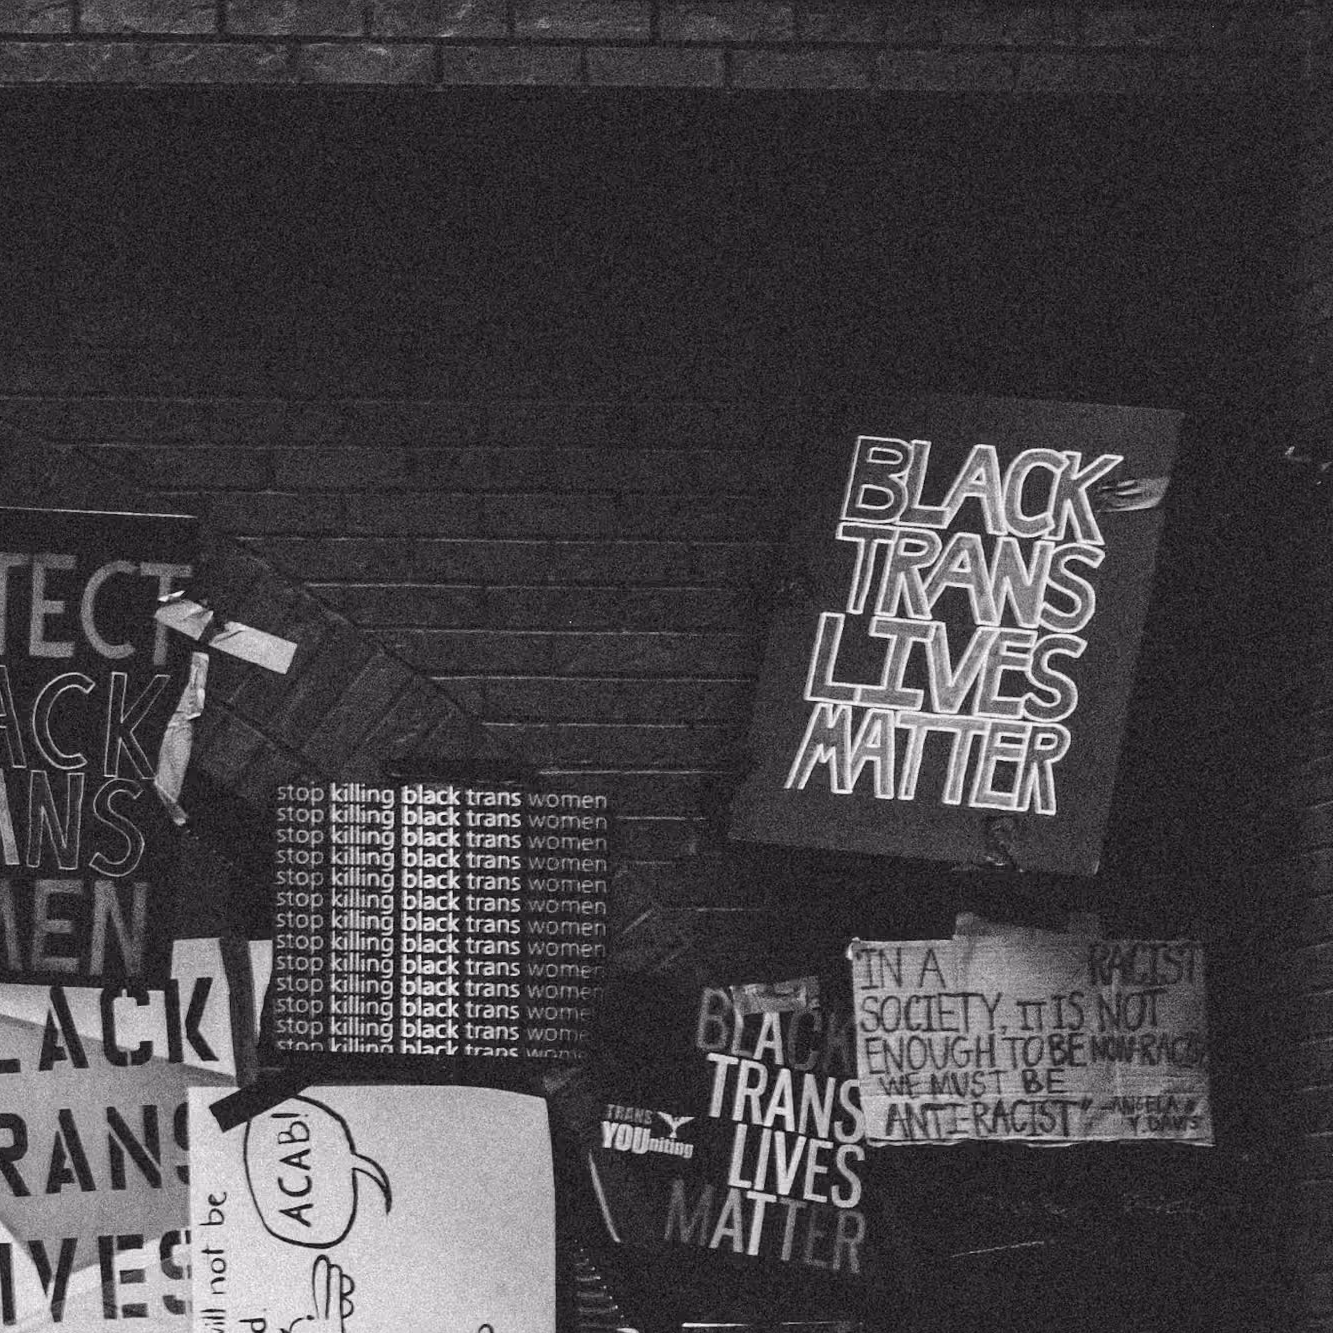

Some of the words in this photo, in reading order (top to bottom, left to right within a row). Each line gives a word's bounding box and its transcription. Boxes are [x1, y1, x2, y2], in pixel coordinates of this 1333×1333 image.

[840, 435, 1124, 545] BLACK
[836, 521, 1106, 633] TRANS
[805, 612, 1088, 722] LIVES
[277, 785, 324, 805] stop
[331, 782, 394, 810] killing
[401, 784, 460, 806] black
[465, 788, 521, 808] trans
[529, 792, 607, 810] women
[785, 701, 1071, 815] MATTER
[857, 947, 903, 990] IN
[919, 950, 947, 989] A
[1017, 1001, 1047, 1031] IT
[1052, 992, 1085, 1030] IS
[1095, 987, 1168, 1032] NOT
[696, 988, 858, 1074] BLACK
[865, 1034, 996, 1074] ENOUGH
[1002, 1036, 1046, 1069] TO
[1049, 1033, 1087, 1067] BE
[707, 1052, 866, 1143] TRANS
[879, 1072, 921, 1098] WE
[931, 1070, 1007, 1097] MUST
[1022, 1069, 1068, 1094] BE
[200, 1190, 228, 1227] be
[272, 1113, 312, 1228] ACAB!
[729, 1123, 866, 1209] LIVES
[665, 1178, 866, 1274] MATTER
[202, 1245, 228, 1296] not
